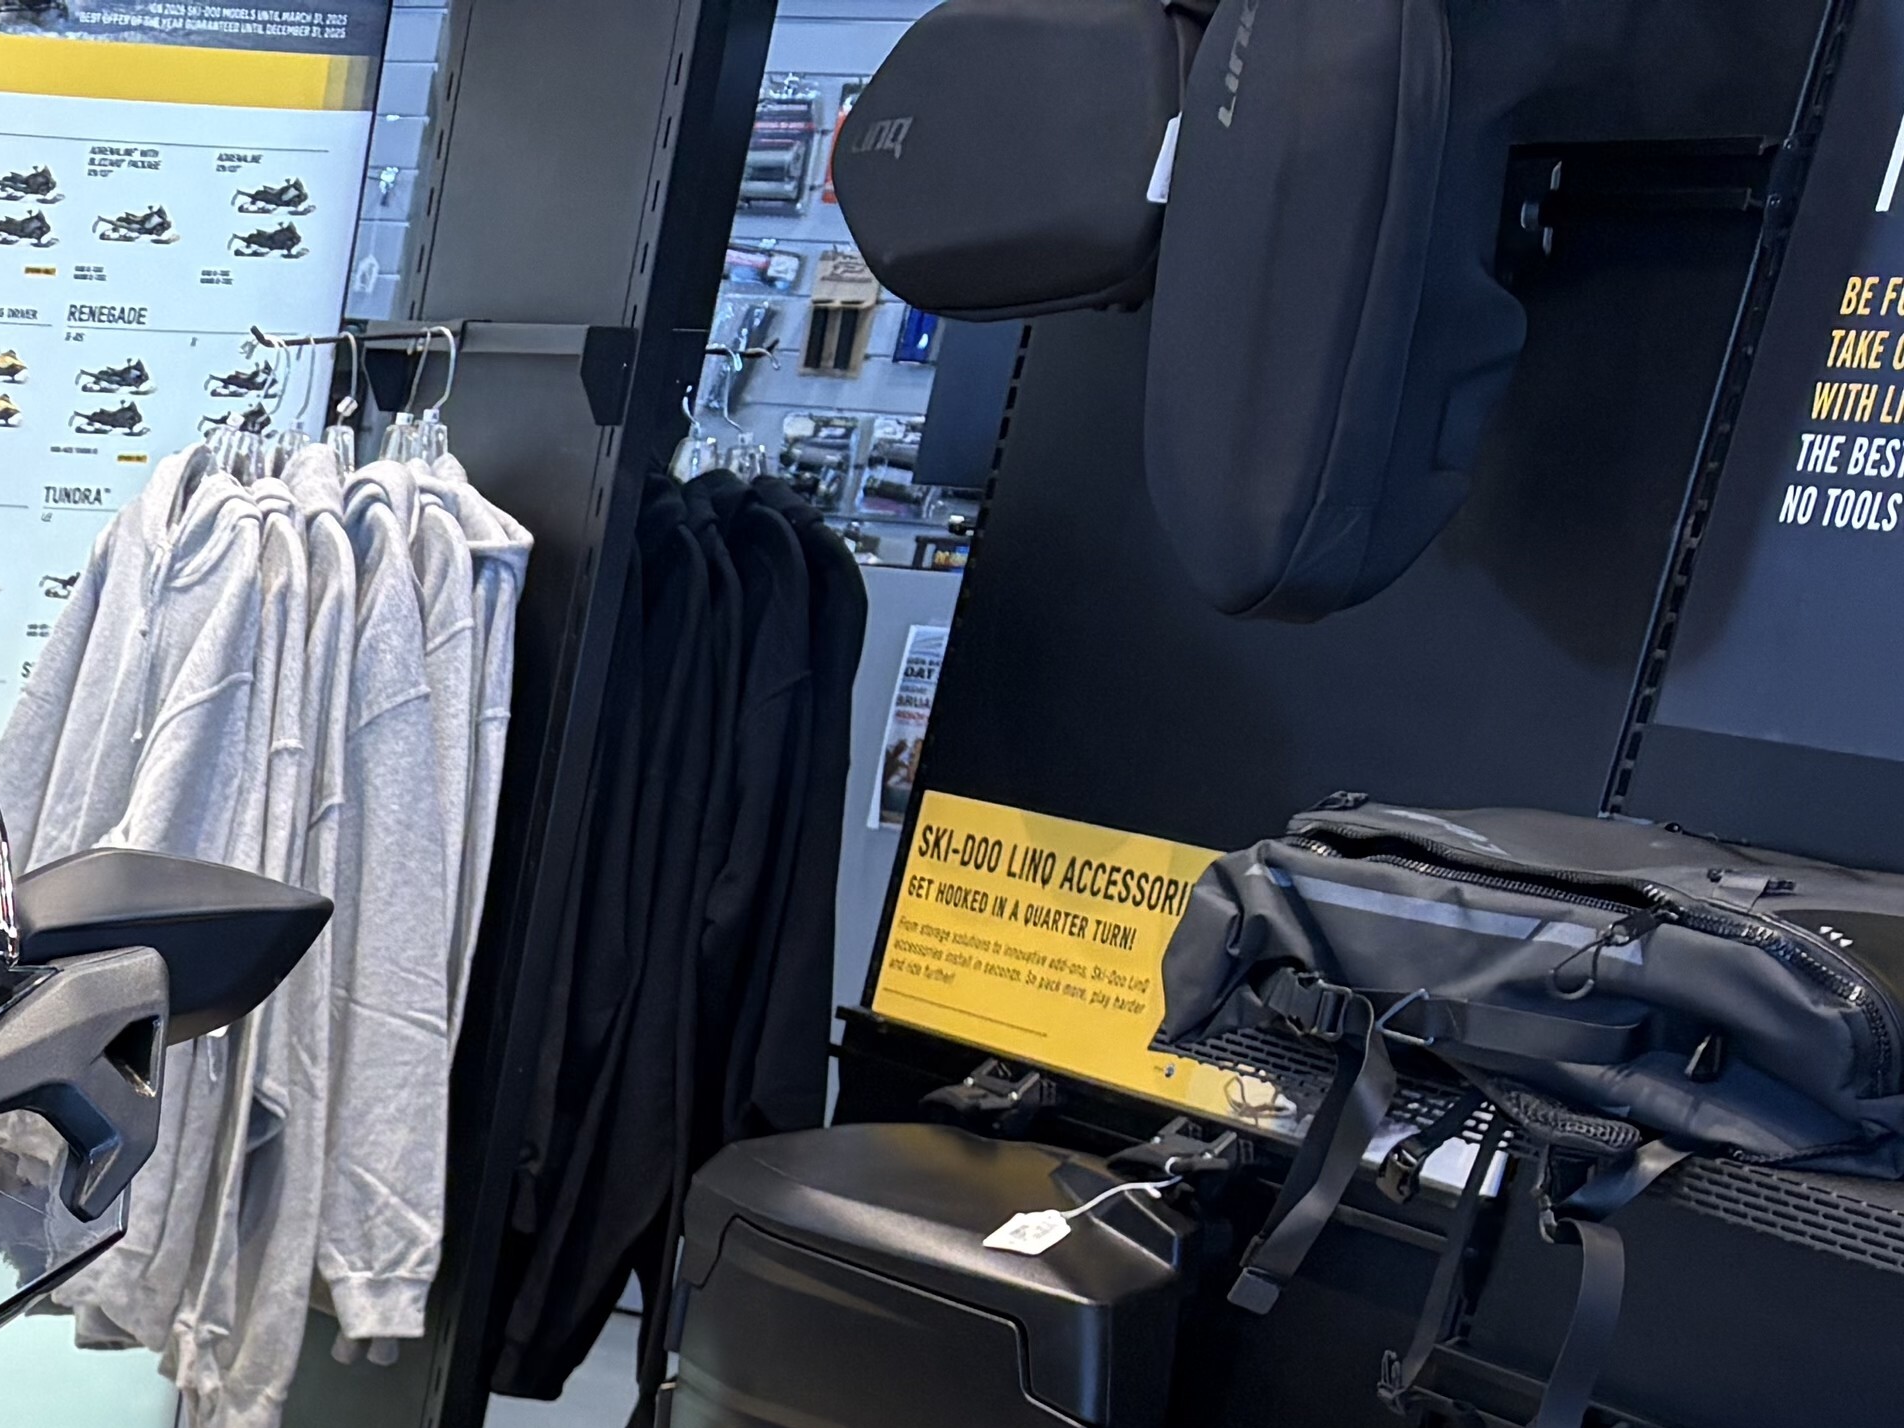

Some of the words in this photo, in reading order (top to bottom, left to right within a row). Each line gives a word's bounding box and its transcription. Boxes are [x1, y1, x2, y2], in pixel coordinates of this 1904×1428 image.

[222, 7, 256, 21] MODELS
[265, 23, 310, 36] DECEMBER
[67, 304, 148, 325] RENEGADE
[1839, 275, 1879, 316] BE
[1826, 329, 1890, 370] TAKE
[1810, 381, 1879, 423] WITH
[1795, 433, 1846, 475] THE
[1847, 437, 1904, 479] BES
[1779, 484, 1819, 526] NO
[1821, 486, 1903, 532] TOOLS
[918, 824, 1003, 874] SKI-DOO
[1006, 843, 1057, 889] LINQ
[1059, 856, 1192, 917] ACCESSORI
[907, 874, 934, 900] GET
[935, 882, 989, 914] HOOKED
[992, 895, 1008, 918] IN
[1008, 899, 1020, 922] A
[1023, 903, 1089, 940] QUARTER
[1092, 919, 1137, 951] TURN!
[920, 924, 951, 943] storage
